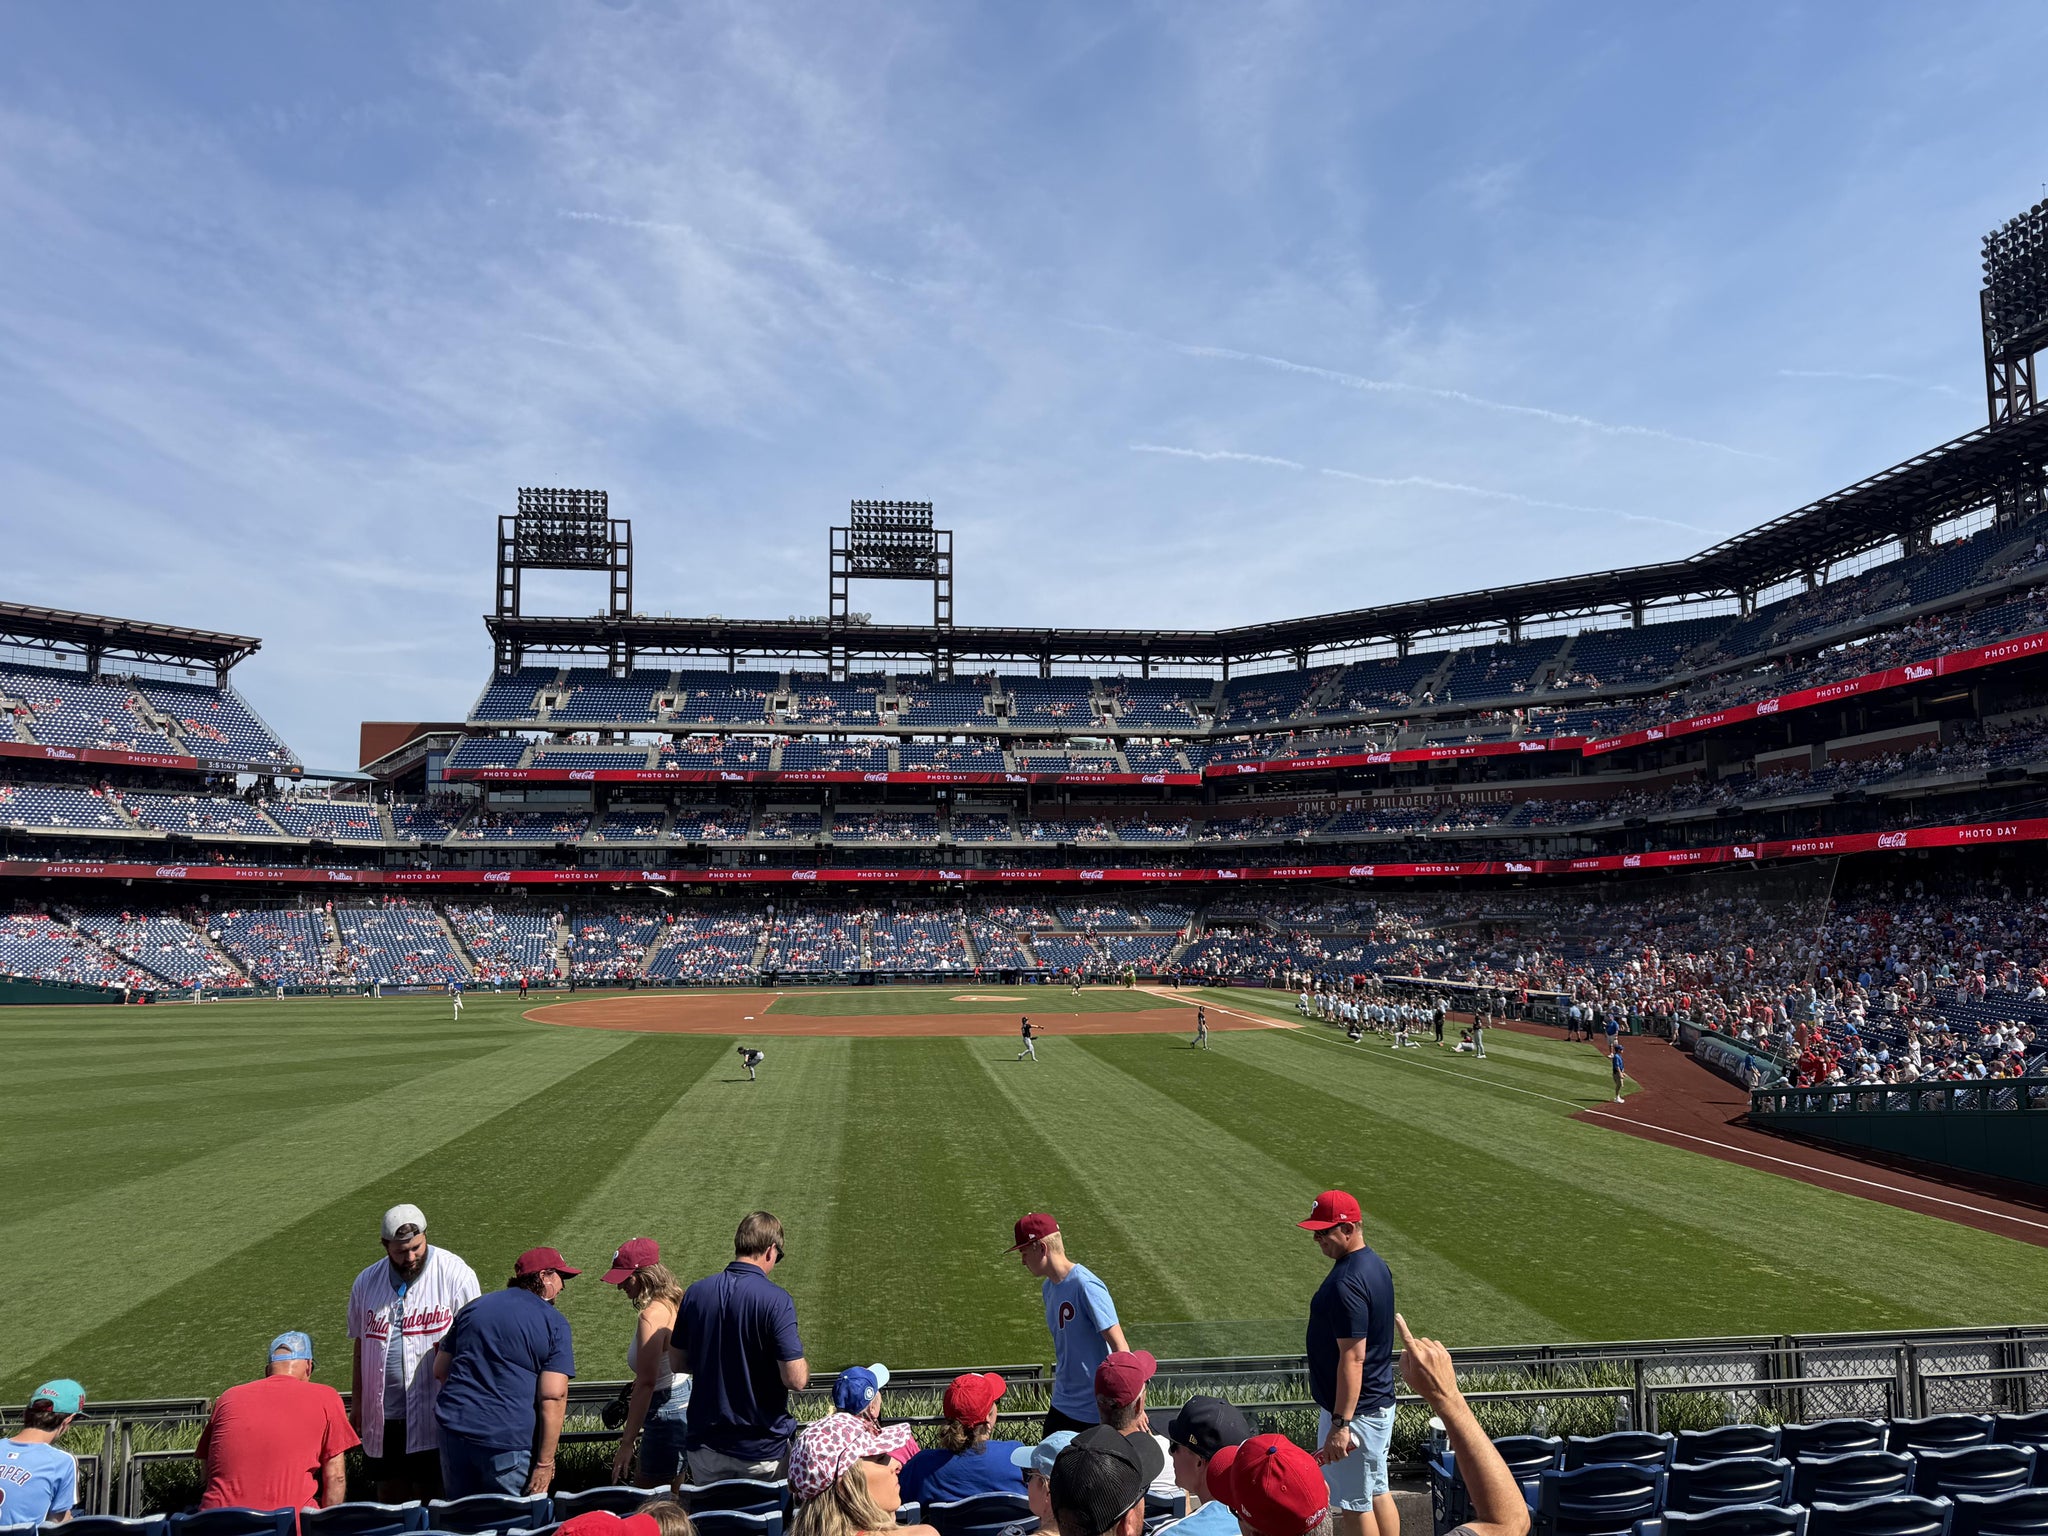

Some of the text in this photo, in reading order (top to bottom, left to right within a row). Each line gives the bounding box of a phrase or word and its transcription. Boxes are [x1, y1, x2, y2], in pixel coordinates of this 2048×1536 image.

[1985, 639, 2043, 658] PHOTO DAY
[1905, 666, 1932, 680] Phillies
[1817, 683, 1858, 698] PHOTO DAY
[1692, 715, 1724, 727] PHOTO DAY
[1647, 730, 1663, 739] Phillies
[1519, 742, 1545, 751] Phillies
[1595, 742, 1611, 750] PHOTO
[46, 747, 76, 759] Phillies
[129, 756, 158, 764] PHOTO
[1237, 765, 1257, 773] Phillies
[721, 772, 743, 780] Phillies
[1006, 774, 1027, 782] Phillies
[1297, 801, 1325, 812] HOME
[1959, 827, 2016, 838] PHOTO DAY
[1792, 842, 1833, 851] PHOTO DAY
[1734, 847, 1754, 858] Phillies
[1505, 863, 1531, 871] Phillies
[328, 871, 352, 880] Phillies
[642, 871, 666, 880] Phillies
[939, 871, 961, 879] Phillies
[1218, 870, 1237, 878] Phillies
[1058, 1300, 1076, 1330] P
